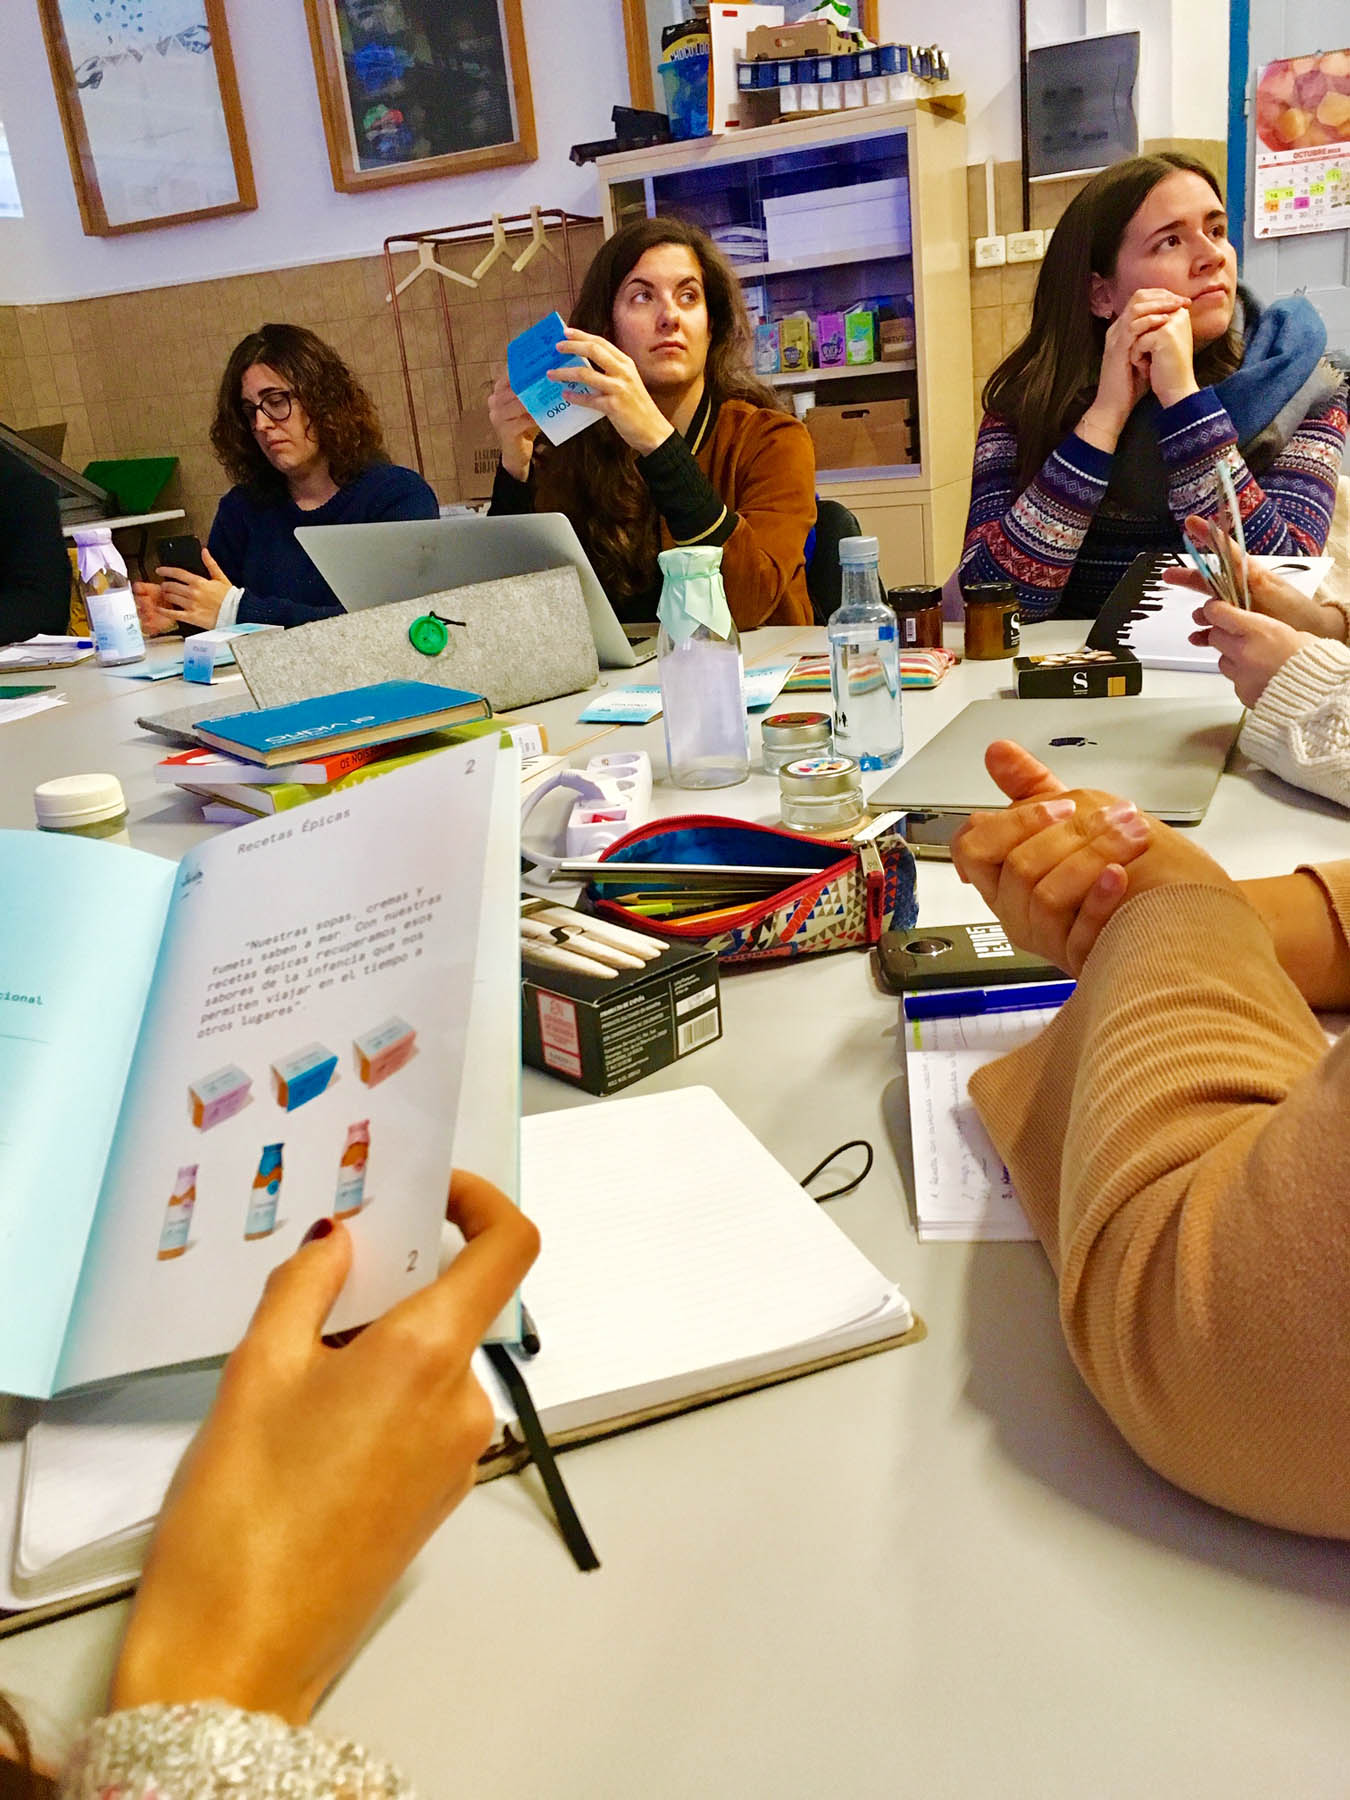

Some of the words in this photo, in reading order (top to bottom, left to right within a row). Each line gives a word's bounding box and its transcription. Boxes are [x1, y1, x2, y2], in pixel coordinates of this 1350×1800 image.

[1073, 671, 1088, 689] S
[464, 759, 476, 775] 2
[237, 828, 294, 854] Recetas
[301, 807, 352, 834] Épicas
[366, 892, 409, 913] cremas
[207, 970, 257, 991] recetas
[316, 926, 396, 959] recuperamos
[404, 912, 433, 929] esos
[212, 957, 253, 976] fumets
[261, 944, 298, 961] saben
[304, 940, 313, 950] a
[355, 918, 378, 933] Con
[384, 893, 442, 921] nuestras
[201, 999, 260, 1025] permiten
[267, 984, 312, 1002] viajar
[319, 978, 334, 990] en
[341, 968, 356, 982] el
[364, 952, 408, 975] tiempo
[415, 946, 424, 957] a
[205, 986, 254, 1007] sabores
[262, 979, 277, 991] de
[285, 973, 300, 984] la
[306, 952, 366, 978] infancia
[373, 942, 395, 958] que
[401, 931, 424, 946] nos
[197, 1021, 233, 1039] otros
[406, 1248, 418, 1272] 2
